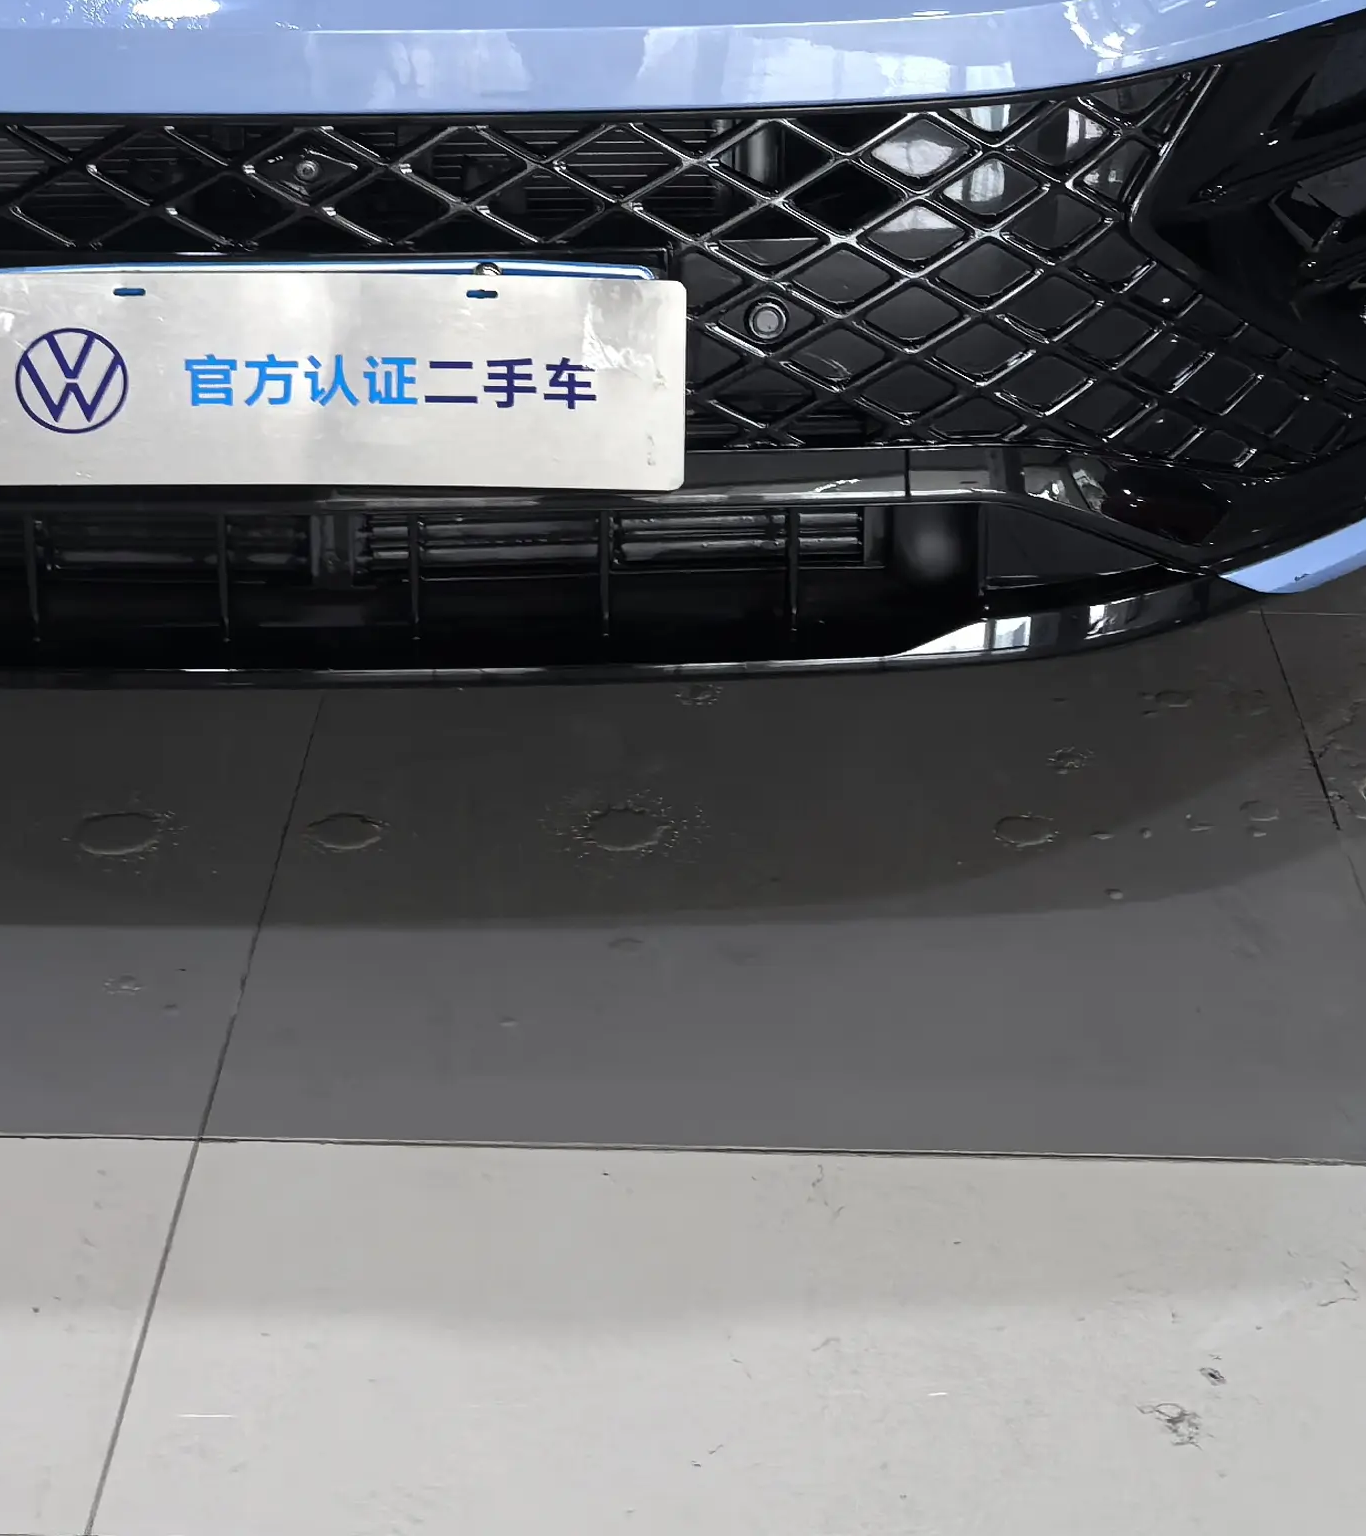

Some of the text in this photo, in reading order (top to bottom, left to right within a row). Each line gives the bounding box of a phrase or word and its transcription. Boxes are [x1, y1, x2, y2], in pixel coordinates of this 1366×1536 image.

[184, 353, 599, 411] 官方认证二手车
